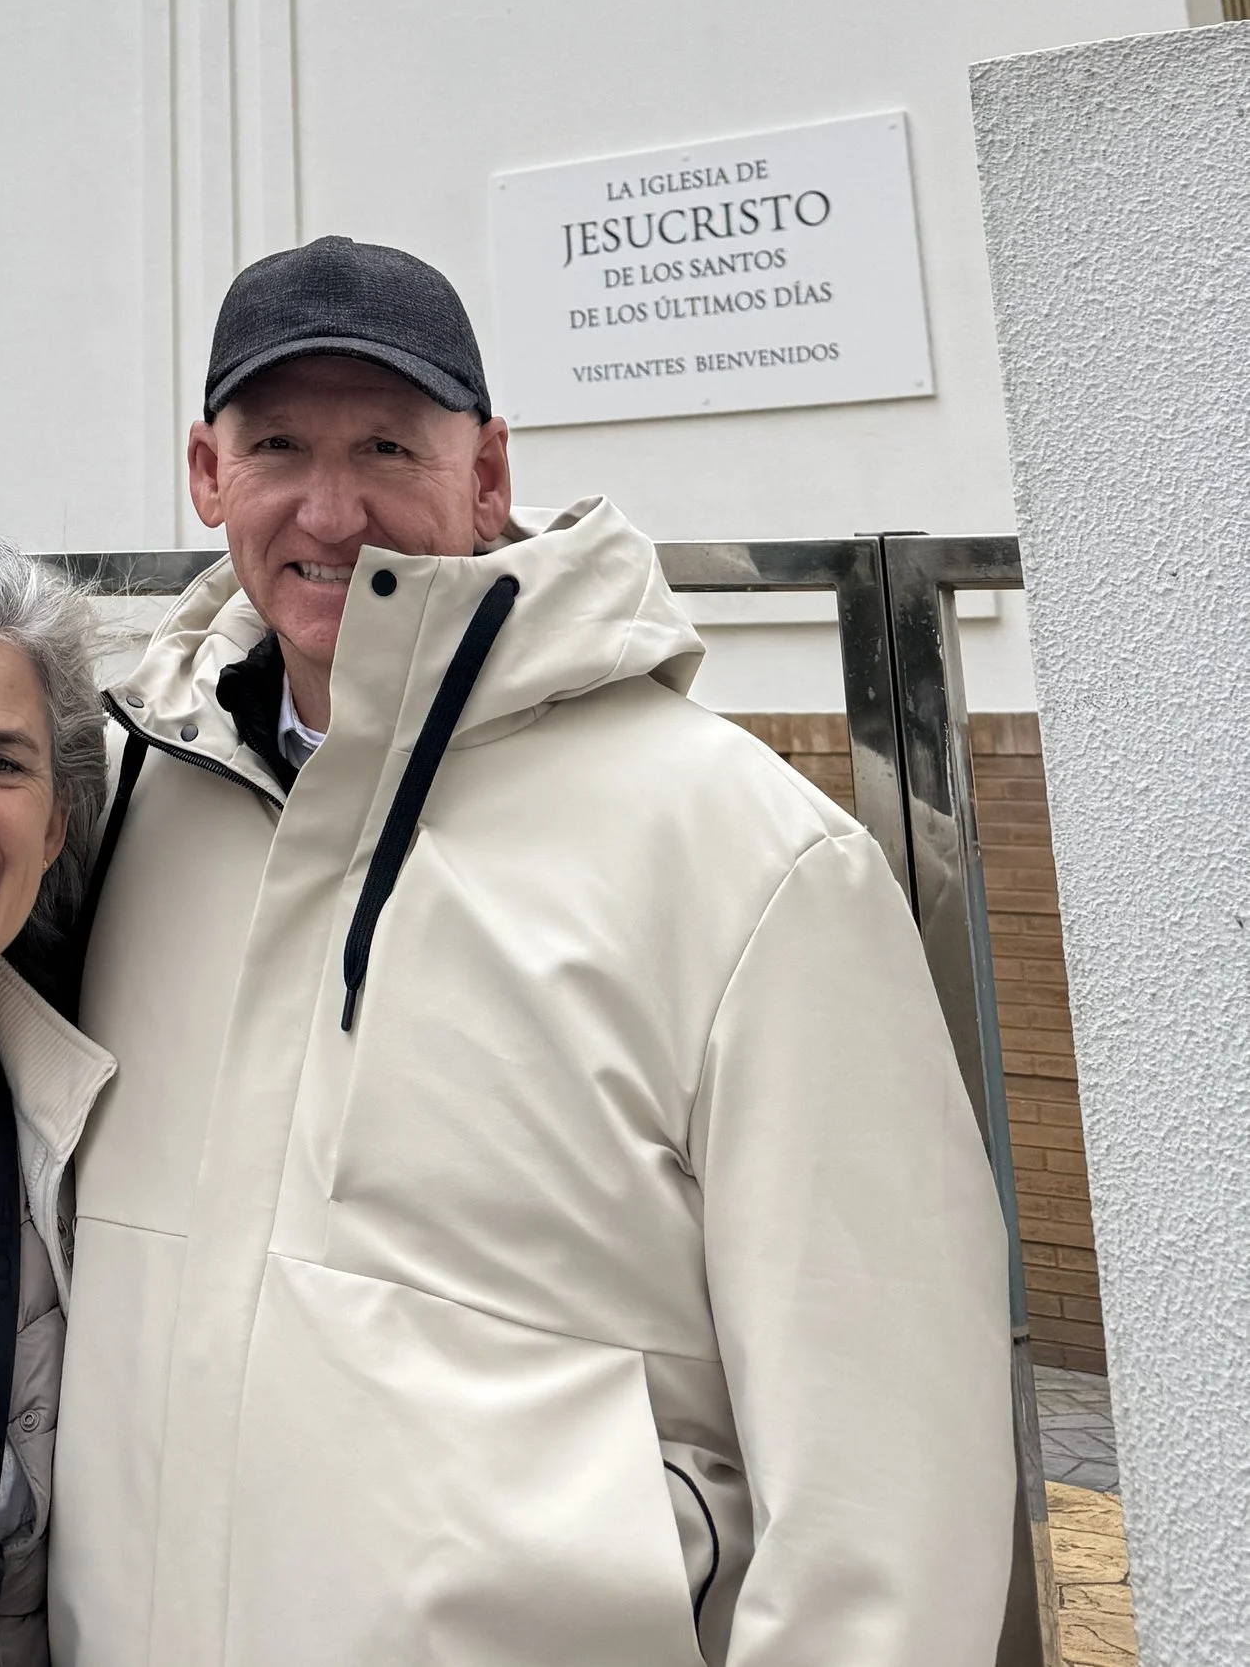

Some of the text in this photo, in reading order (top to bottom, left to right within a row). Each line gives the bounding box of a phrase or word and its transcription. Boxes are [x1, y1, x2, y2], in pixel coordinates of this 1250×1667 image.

[606, 160, 769, 202] LA IGLESIA DE
[561, 190, 831, 268] JESUCRISTO
[603, 248, 787, 289] DE LOS SANTOS
[569, 281, 833, 330] DE LOS ÚLTIMOS DÍAS
[572, 342, 840, 383] VISITANTES BIENVENIDOS
